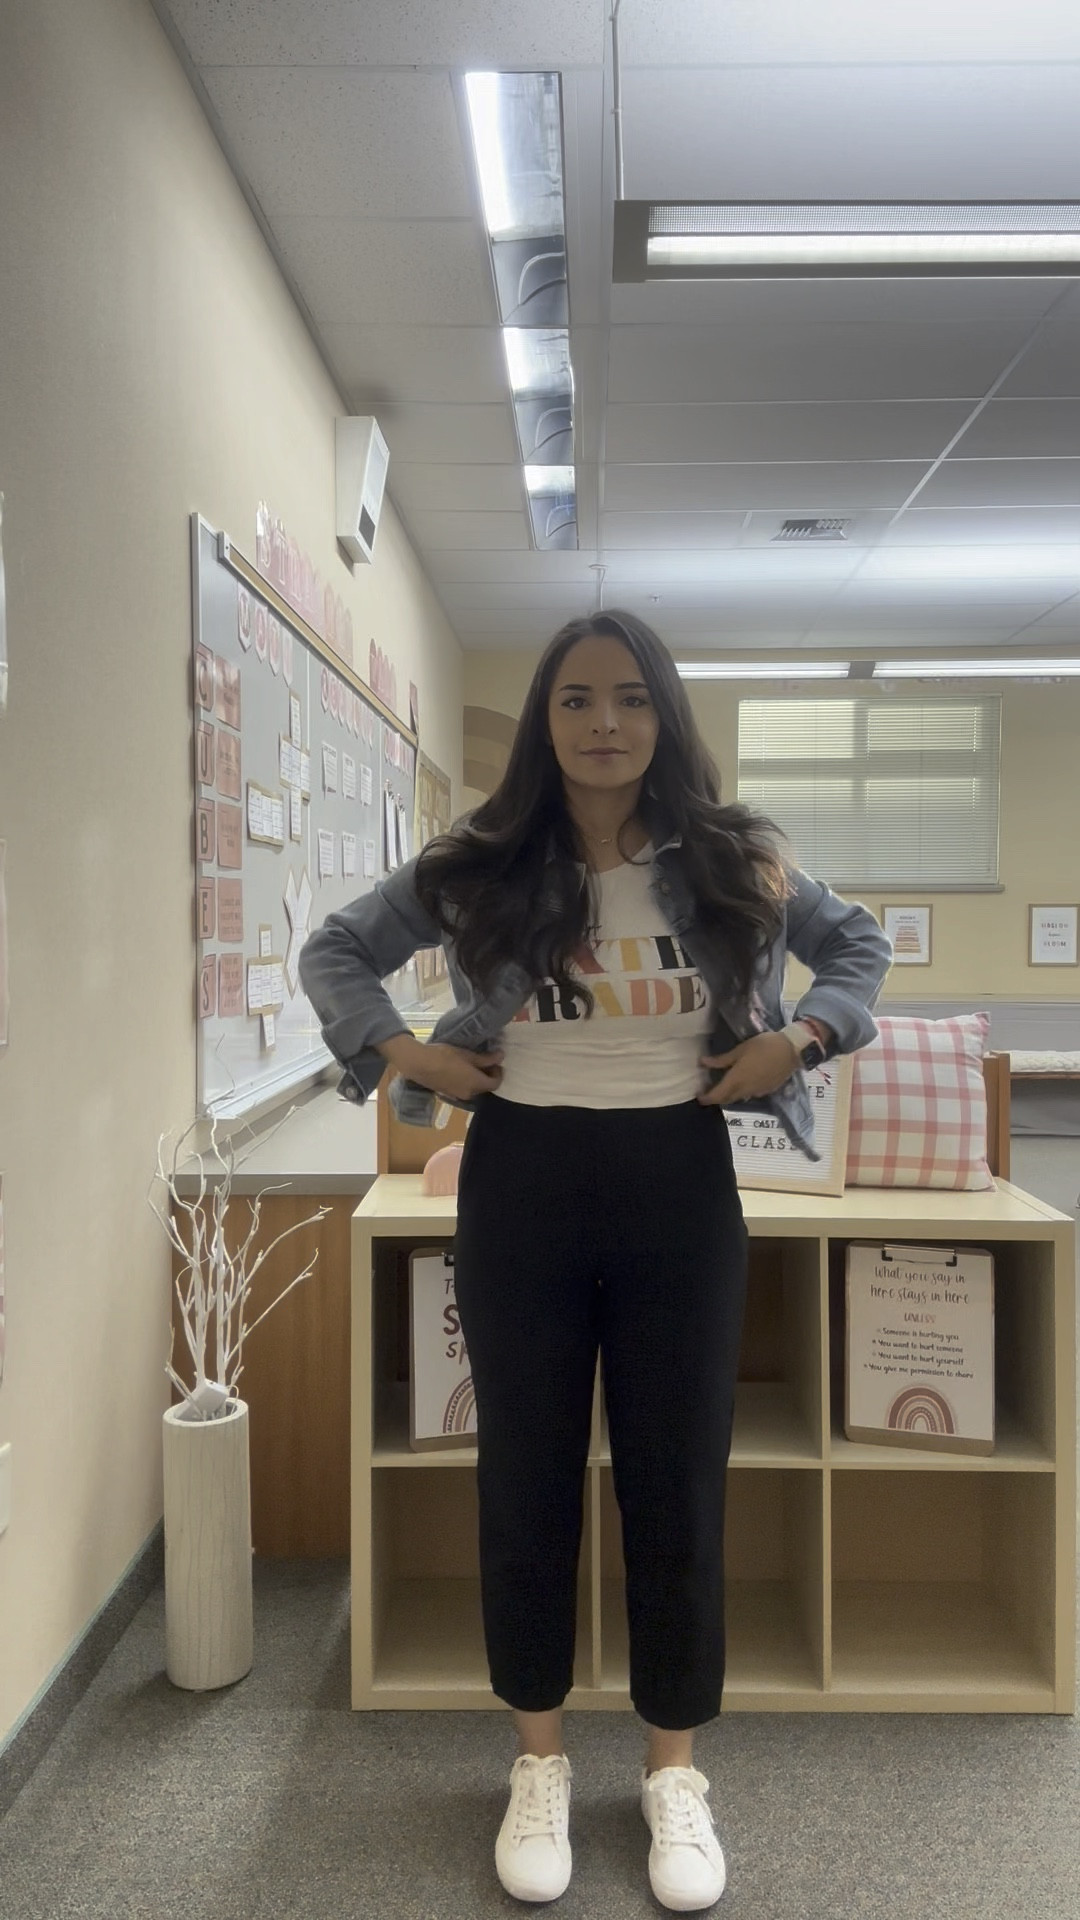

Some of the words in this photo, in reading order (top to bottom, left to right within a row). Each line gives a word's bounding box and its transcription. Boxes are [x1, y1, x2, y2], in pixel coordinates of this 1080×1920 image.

[510, 974, 707, 1022] RADE
[753, 1120, 784, 1129] CAST
[737, 1134, 799, 1151] CLAS
[874, 1265, 900, 1280] What
[905, 1272, 927, 1284] you
[932, 1272, 951, 1287] say
[955, 1274, 965, 1284] in
[870, 1284, 895, 1299] here
[897, 1286, 927, 1304] stays
[931, 1292, 941, 1302] in
[945, 1289, 969, 1305] here
[443, 1303, 461, 1336] S
[882, 1327, 910, 1337] Someone
[919, 1331, 945, 1343] hurting
[946, 1334, 959, 1344] you
[878, 1339, 891, 1348] You
[893, 1341, 910, 1349] want
[911, 1341, 918, 1349] to
[919, 1343, 935, 1351] hurt
[936, 1345, 964, 1354] someone
[878, 1351, 891, 1360] You
[893, 1353, 910, 1361] want
[919, 1355, 935, 1363] hurt
[936, 1357, 965, 1368] yourself
[868, 1362, 882, 1371] You
[884, 1364, 897, 1374] give
[911, 1367, 945, 1376] permission
[946, 1369, 954, 1377] to
[955, 1370, 974, 1379] share
